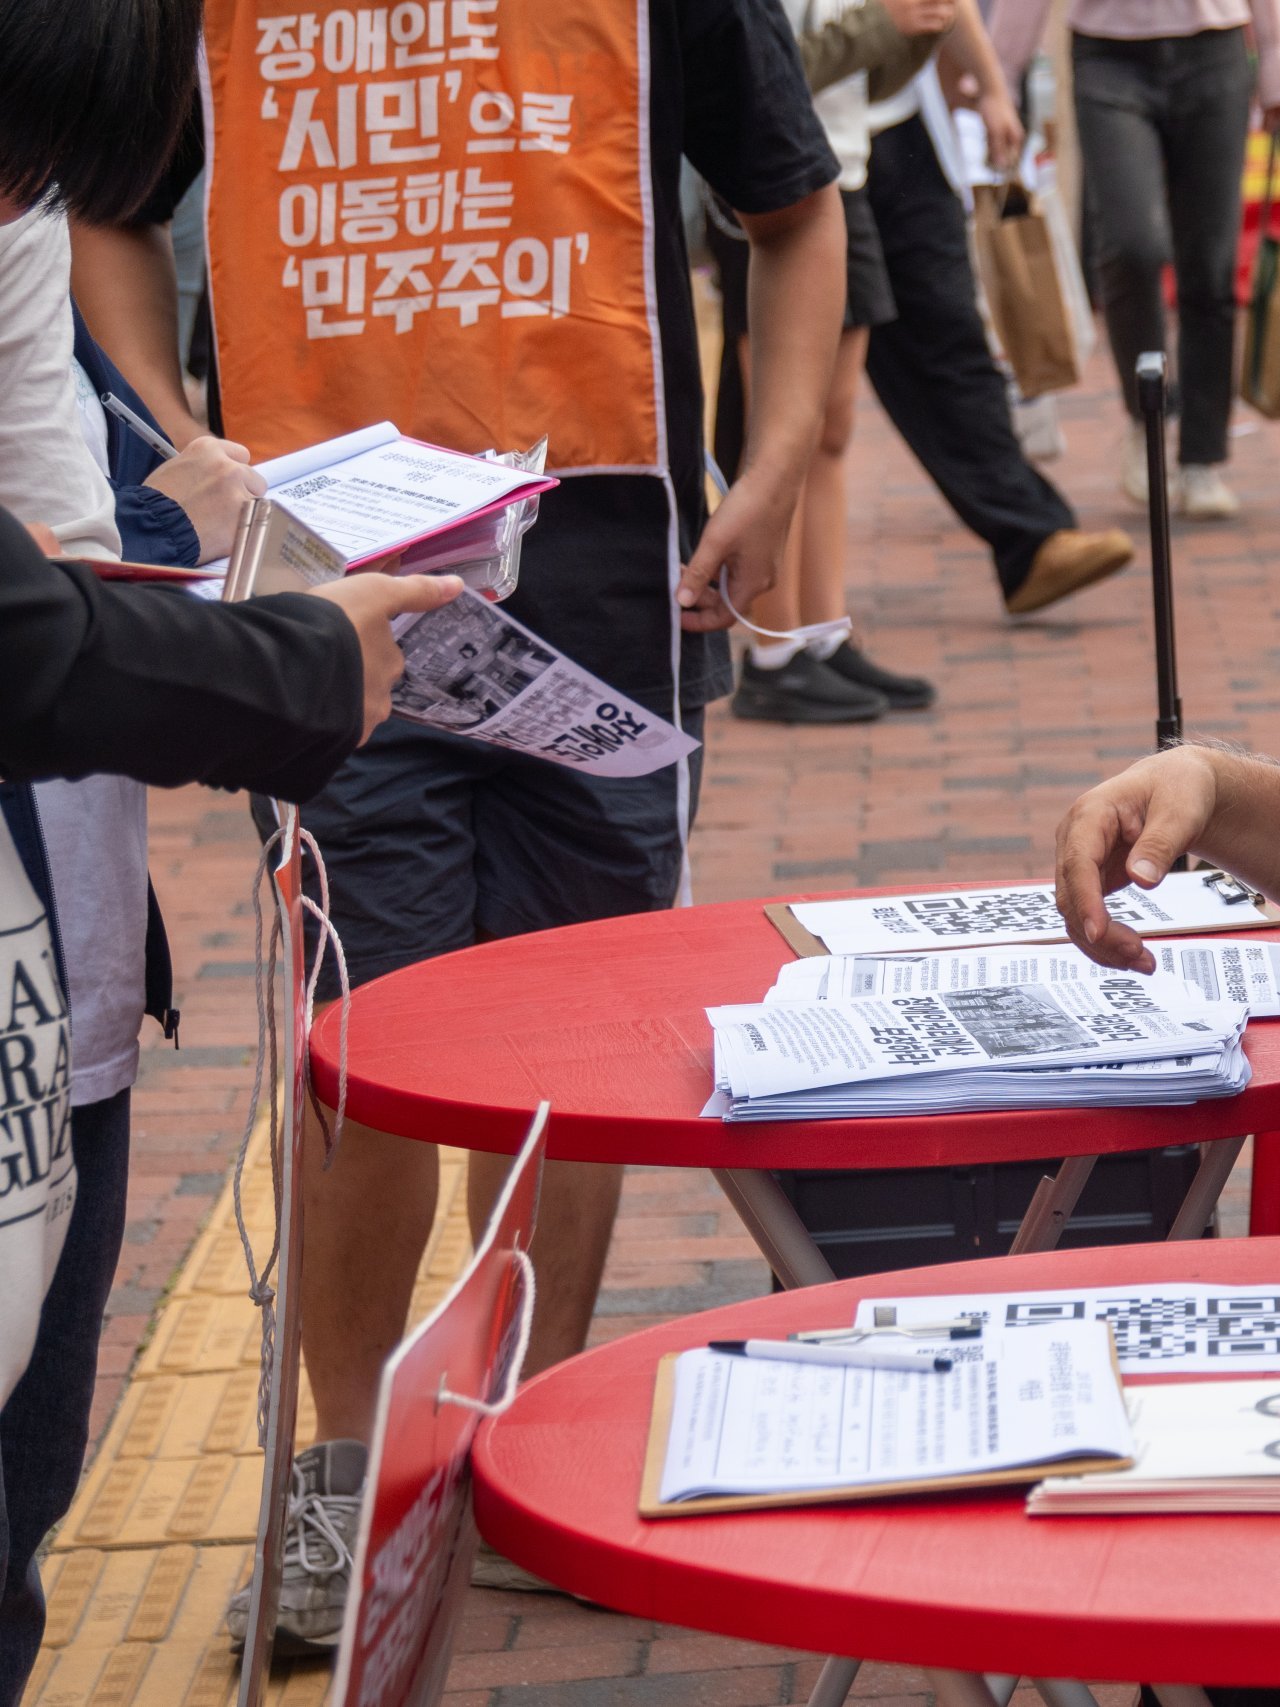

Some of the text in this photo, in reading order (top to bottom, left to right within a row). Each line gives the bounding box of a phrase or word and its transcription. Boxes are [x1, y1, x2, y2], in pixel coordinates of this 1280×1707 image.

[256, 0, 501, 81] 장애인도
[278, 167, 515, 248] 이동하는
[281, 233, 590, 340] ‘민주주의’
[540, 702, 648, 763] 장애인도
[892, 995, 981, 1059] 장애인권리예산
[1076, 1012, 1137, 1043] 권리없다
[1101, 978, 1169, 1015] 예산없이
[873, 1024, 935, 1066] 보장하라
